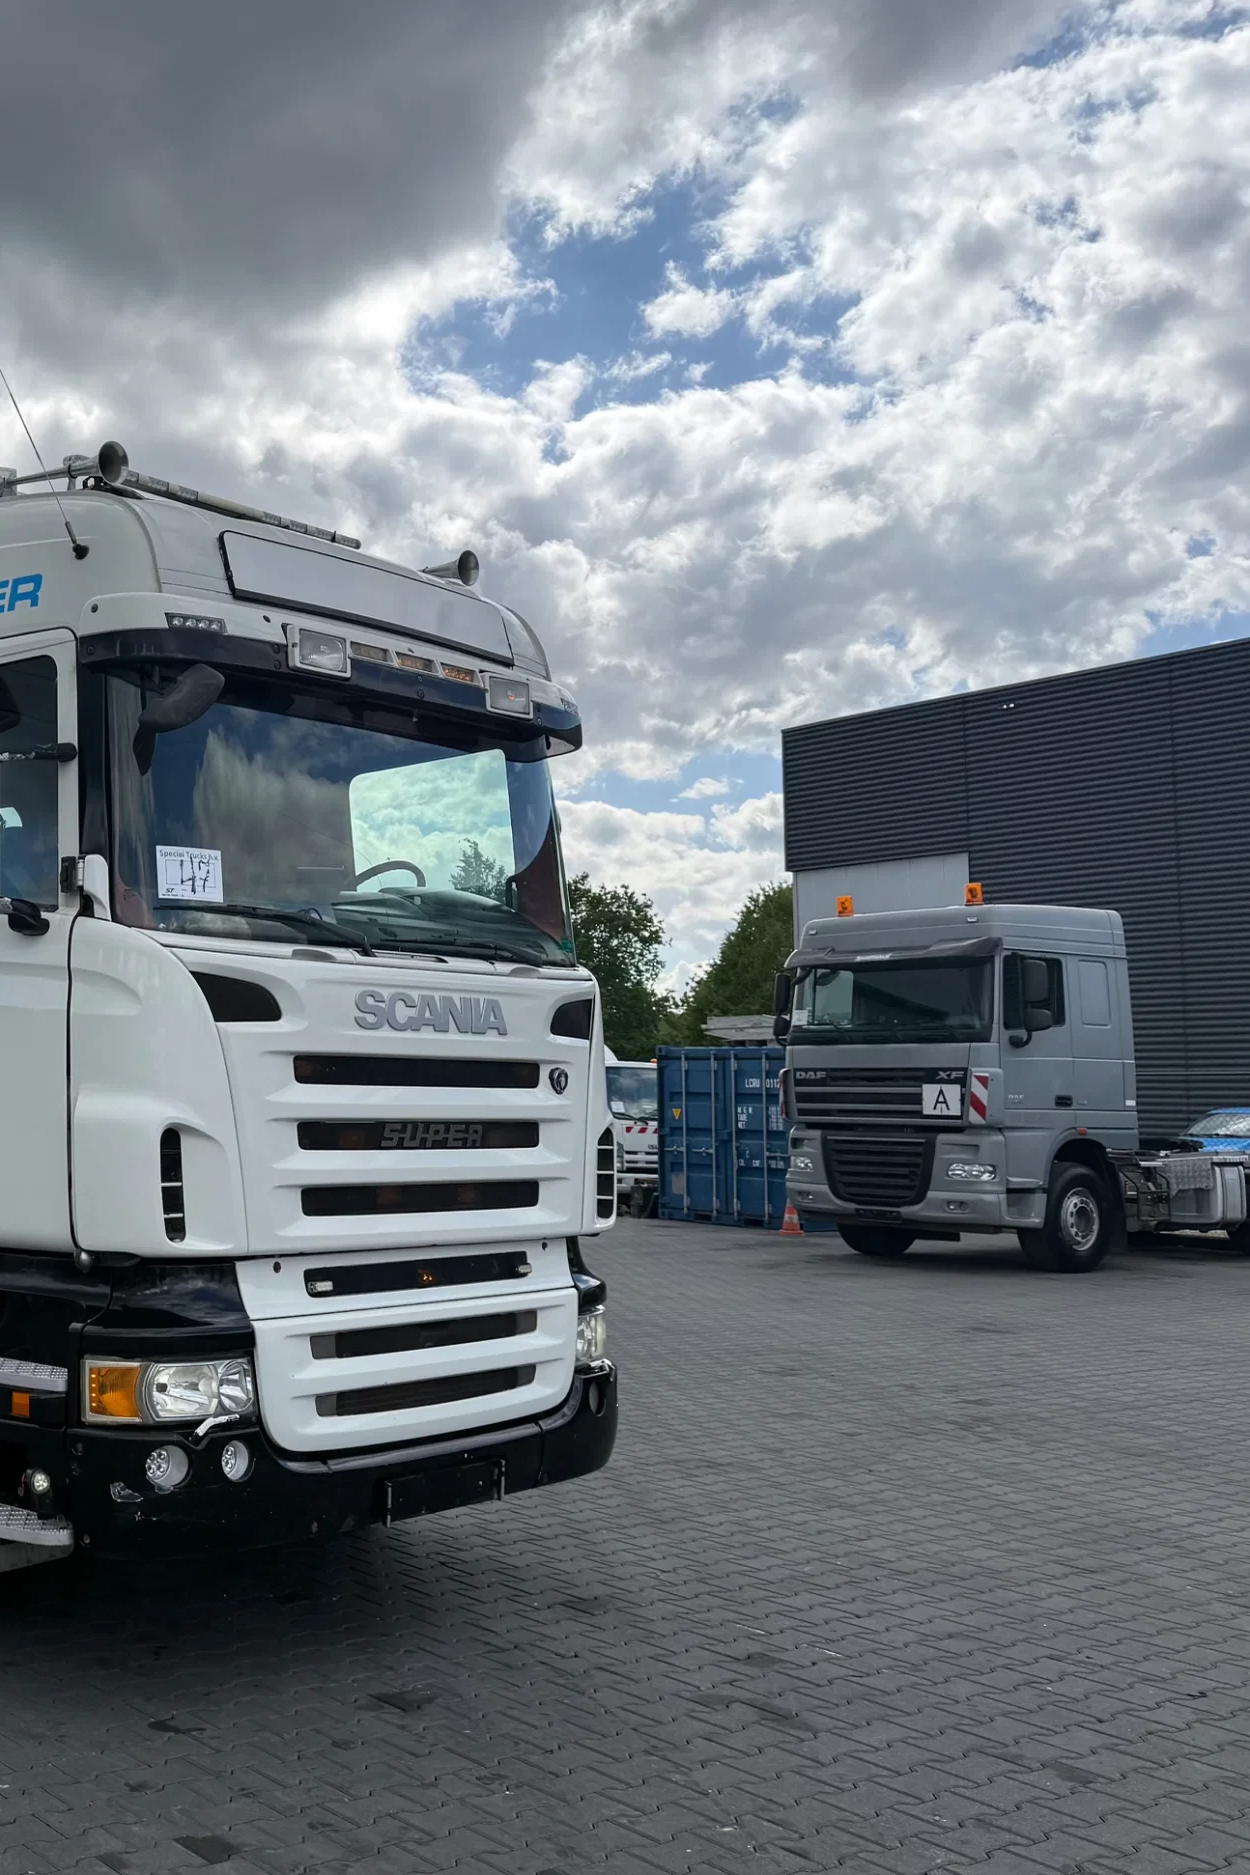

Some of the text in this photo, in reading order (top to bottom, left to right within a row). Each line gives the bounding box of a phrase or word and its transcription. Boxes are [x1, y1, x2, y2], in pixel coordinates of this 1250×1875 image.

[159, 849, 185, 858] Special
[186, 851, 207, 860] Trucks
[354, 989, 508, 1036] SCANIA
[795, 1071, 827, 1080] DAF
[935, 1071, 965, 1080] XF
[933, 1087, 950, 1111] A
[381, 1123, 483, 1147] SUPER
